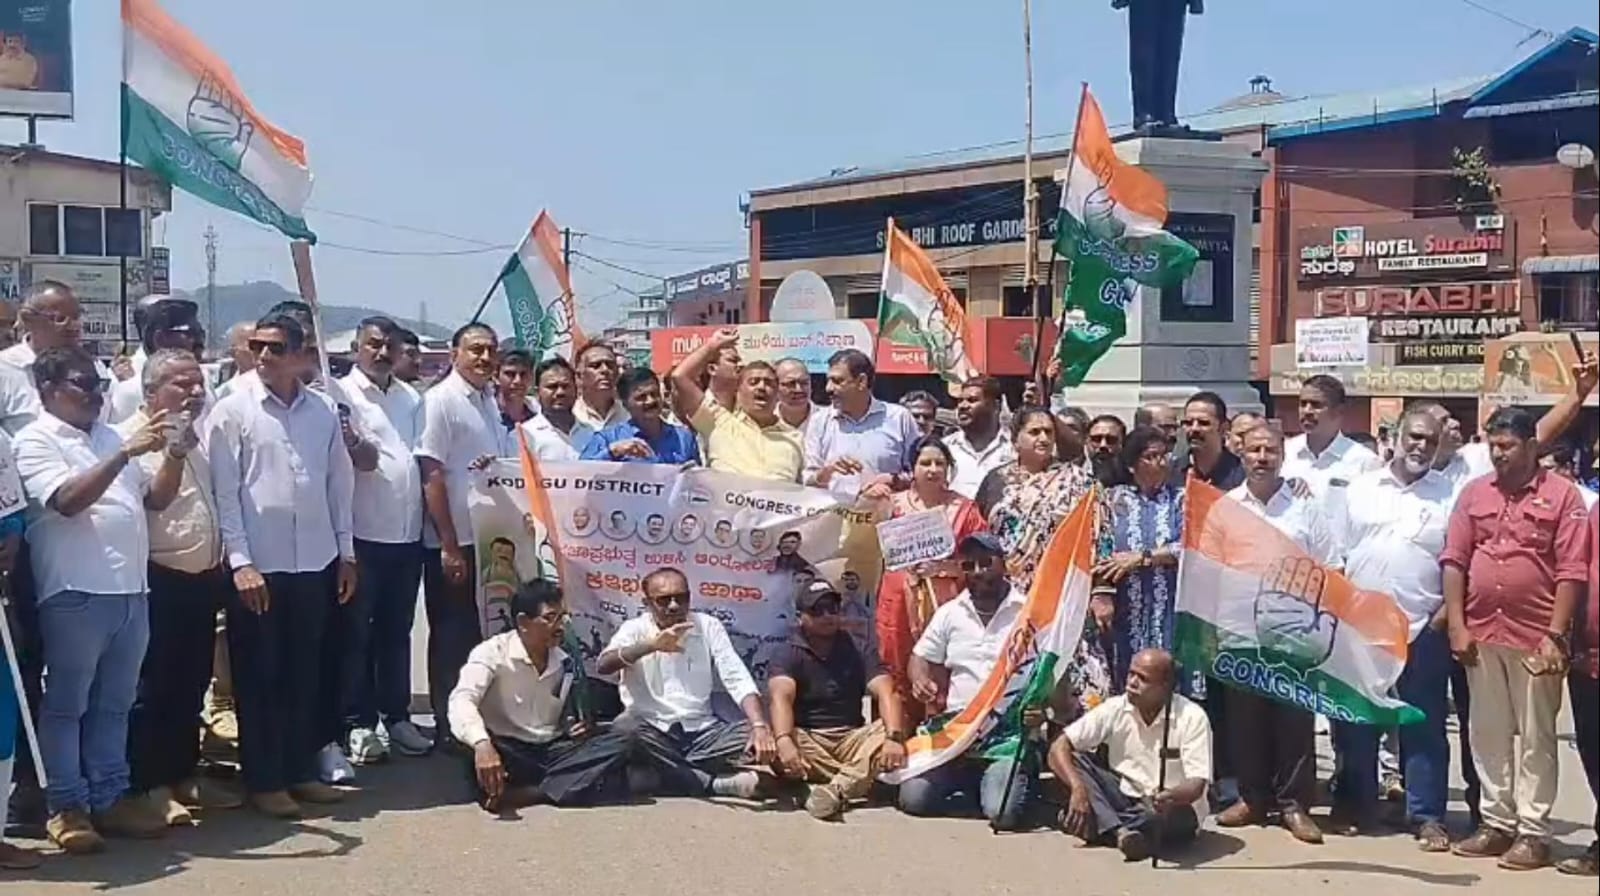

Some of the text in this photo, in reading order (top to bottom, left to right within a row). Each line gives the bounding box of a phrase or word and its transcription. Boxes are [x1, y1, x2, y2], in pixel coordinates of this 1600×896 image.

[876, 226, 935, 247] SBHI
[942, 223, 976, 243] ROOF
[1365, 240, 1417, 257] HOTEL
[1382, 255, 1483, 269] FAMILY RESTAURANT
[1319, 283, 1519, 315] SURABHI
[1381, 318, 1522, 338] RESTAURANT
[1404, 344, 1486, 358] FISH CURRY RIC
[487, 476, 567, 490] KODGU
[575, 478, 665, 496] DISTRICT
[1212, 651, 1372, 725] CONGRES
